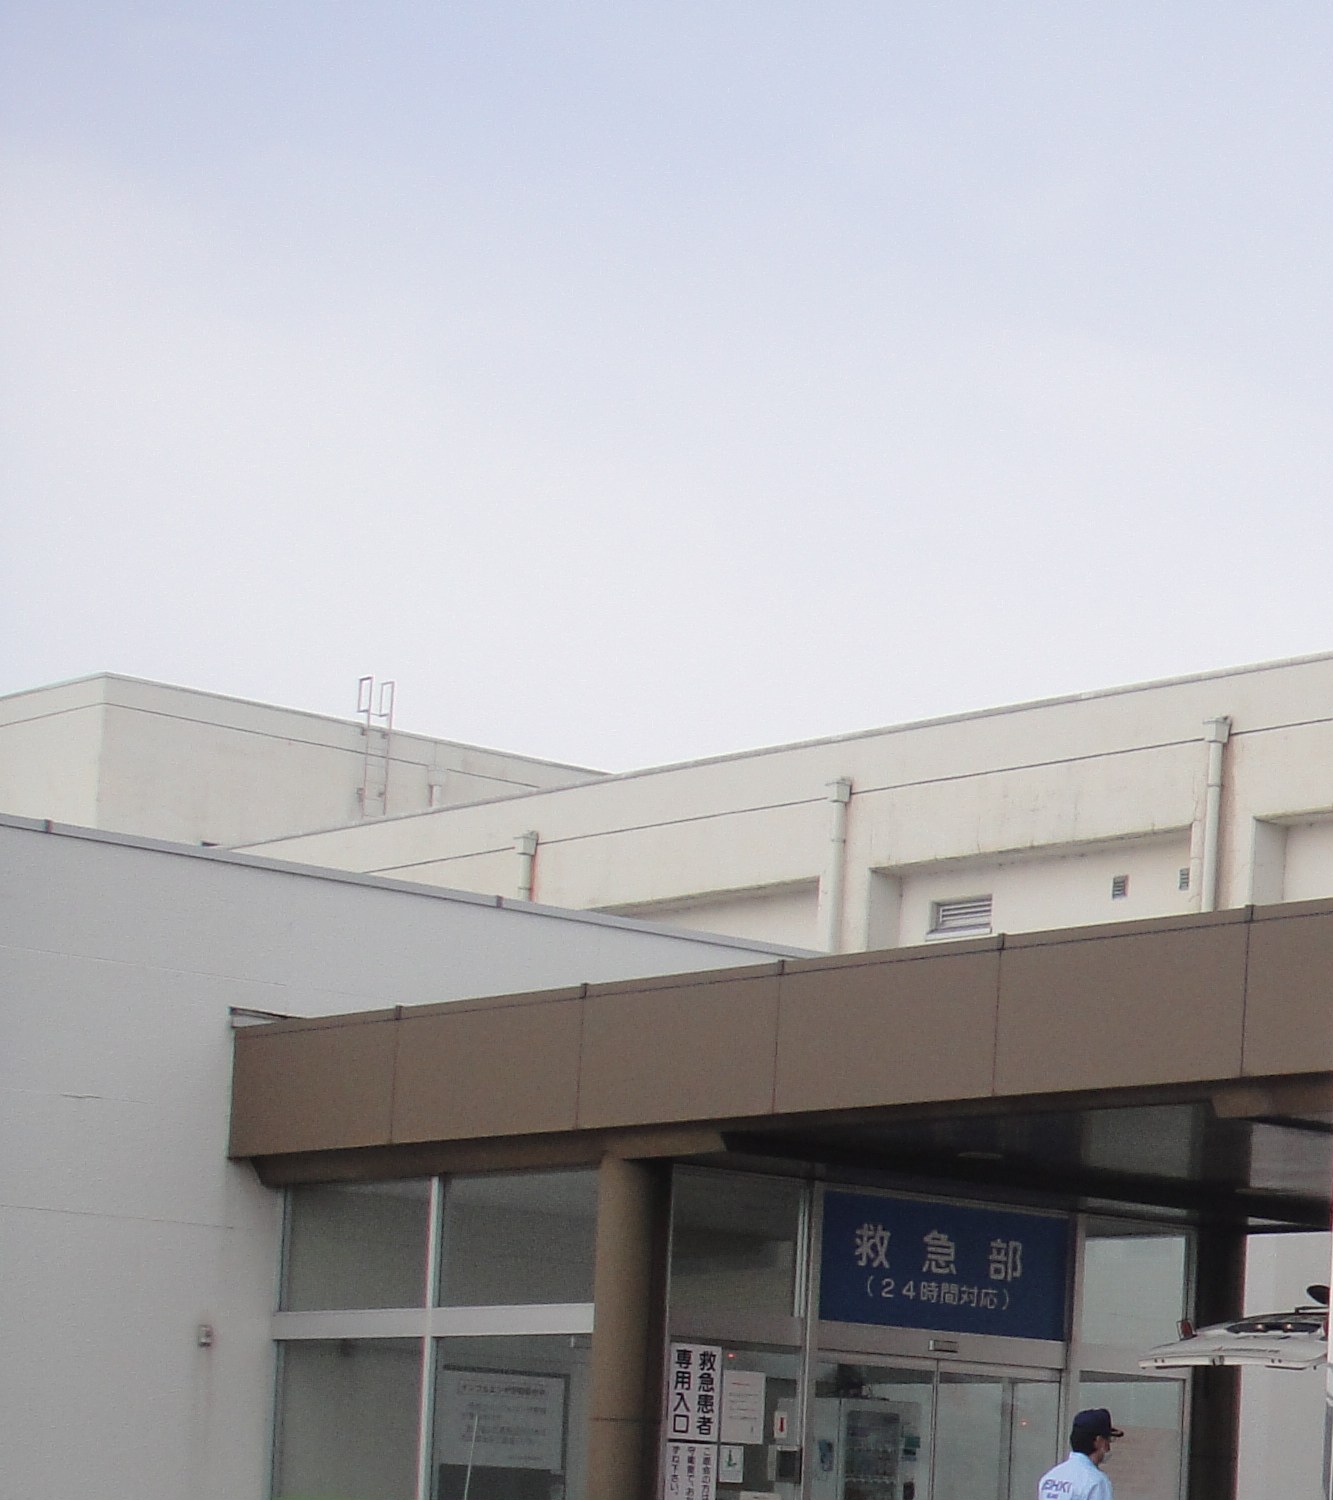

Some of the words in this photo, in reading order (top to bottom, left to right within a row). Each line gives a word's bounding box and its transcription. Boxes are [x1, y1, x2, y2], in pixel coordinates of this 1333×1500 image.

[855, 1223, 1023, 1282] 救急部
[673, 1349, 692, 1434] 専用入口
[696, 1351, 717, 1436] 救急患者
